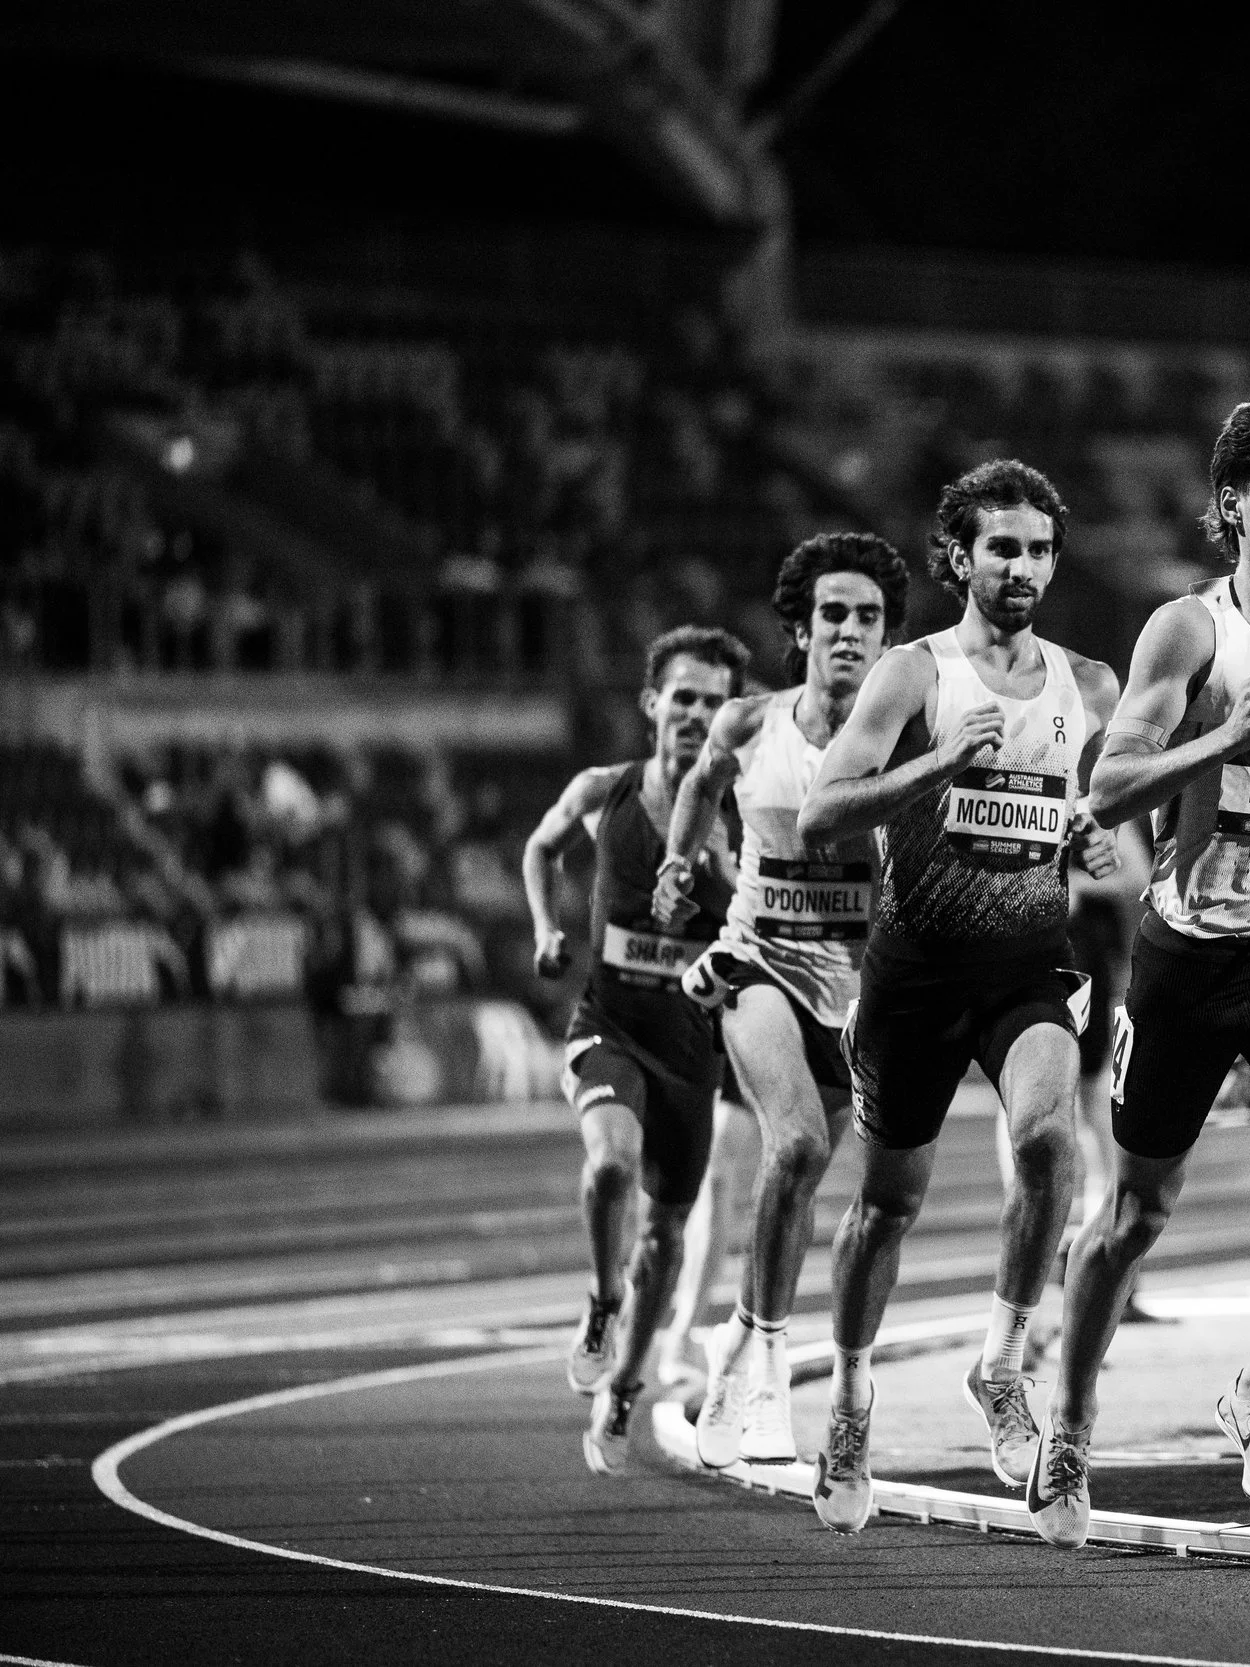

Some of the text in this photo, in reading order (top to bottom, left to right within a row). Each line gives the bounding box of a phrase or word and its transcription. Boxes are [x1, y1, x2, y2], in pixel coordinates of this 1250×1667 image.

[1008, 780, 1043, 788] ATHLETICS
[957, 798, 1059, 833] MCDONALD
[990, 841, 1021, 849] SUMMER
[765, 886, 863, 912] O'DONNELL
